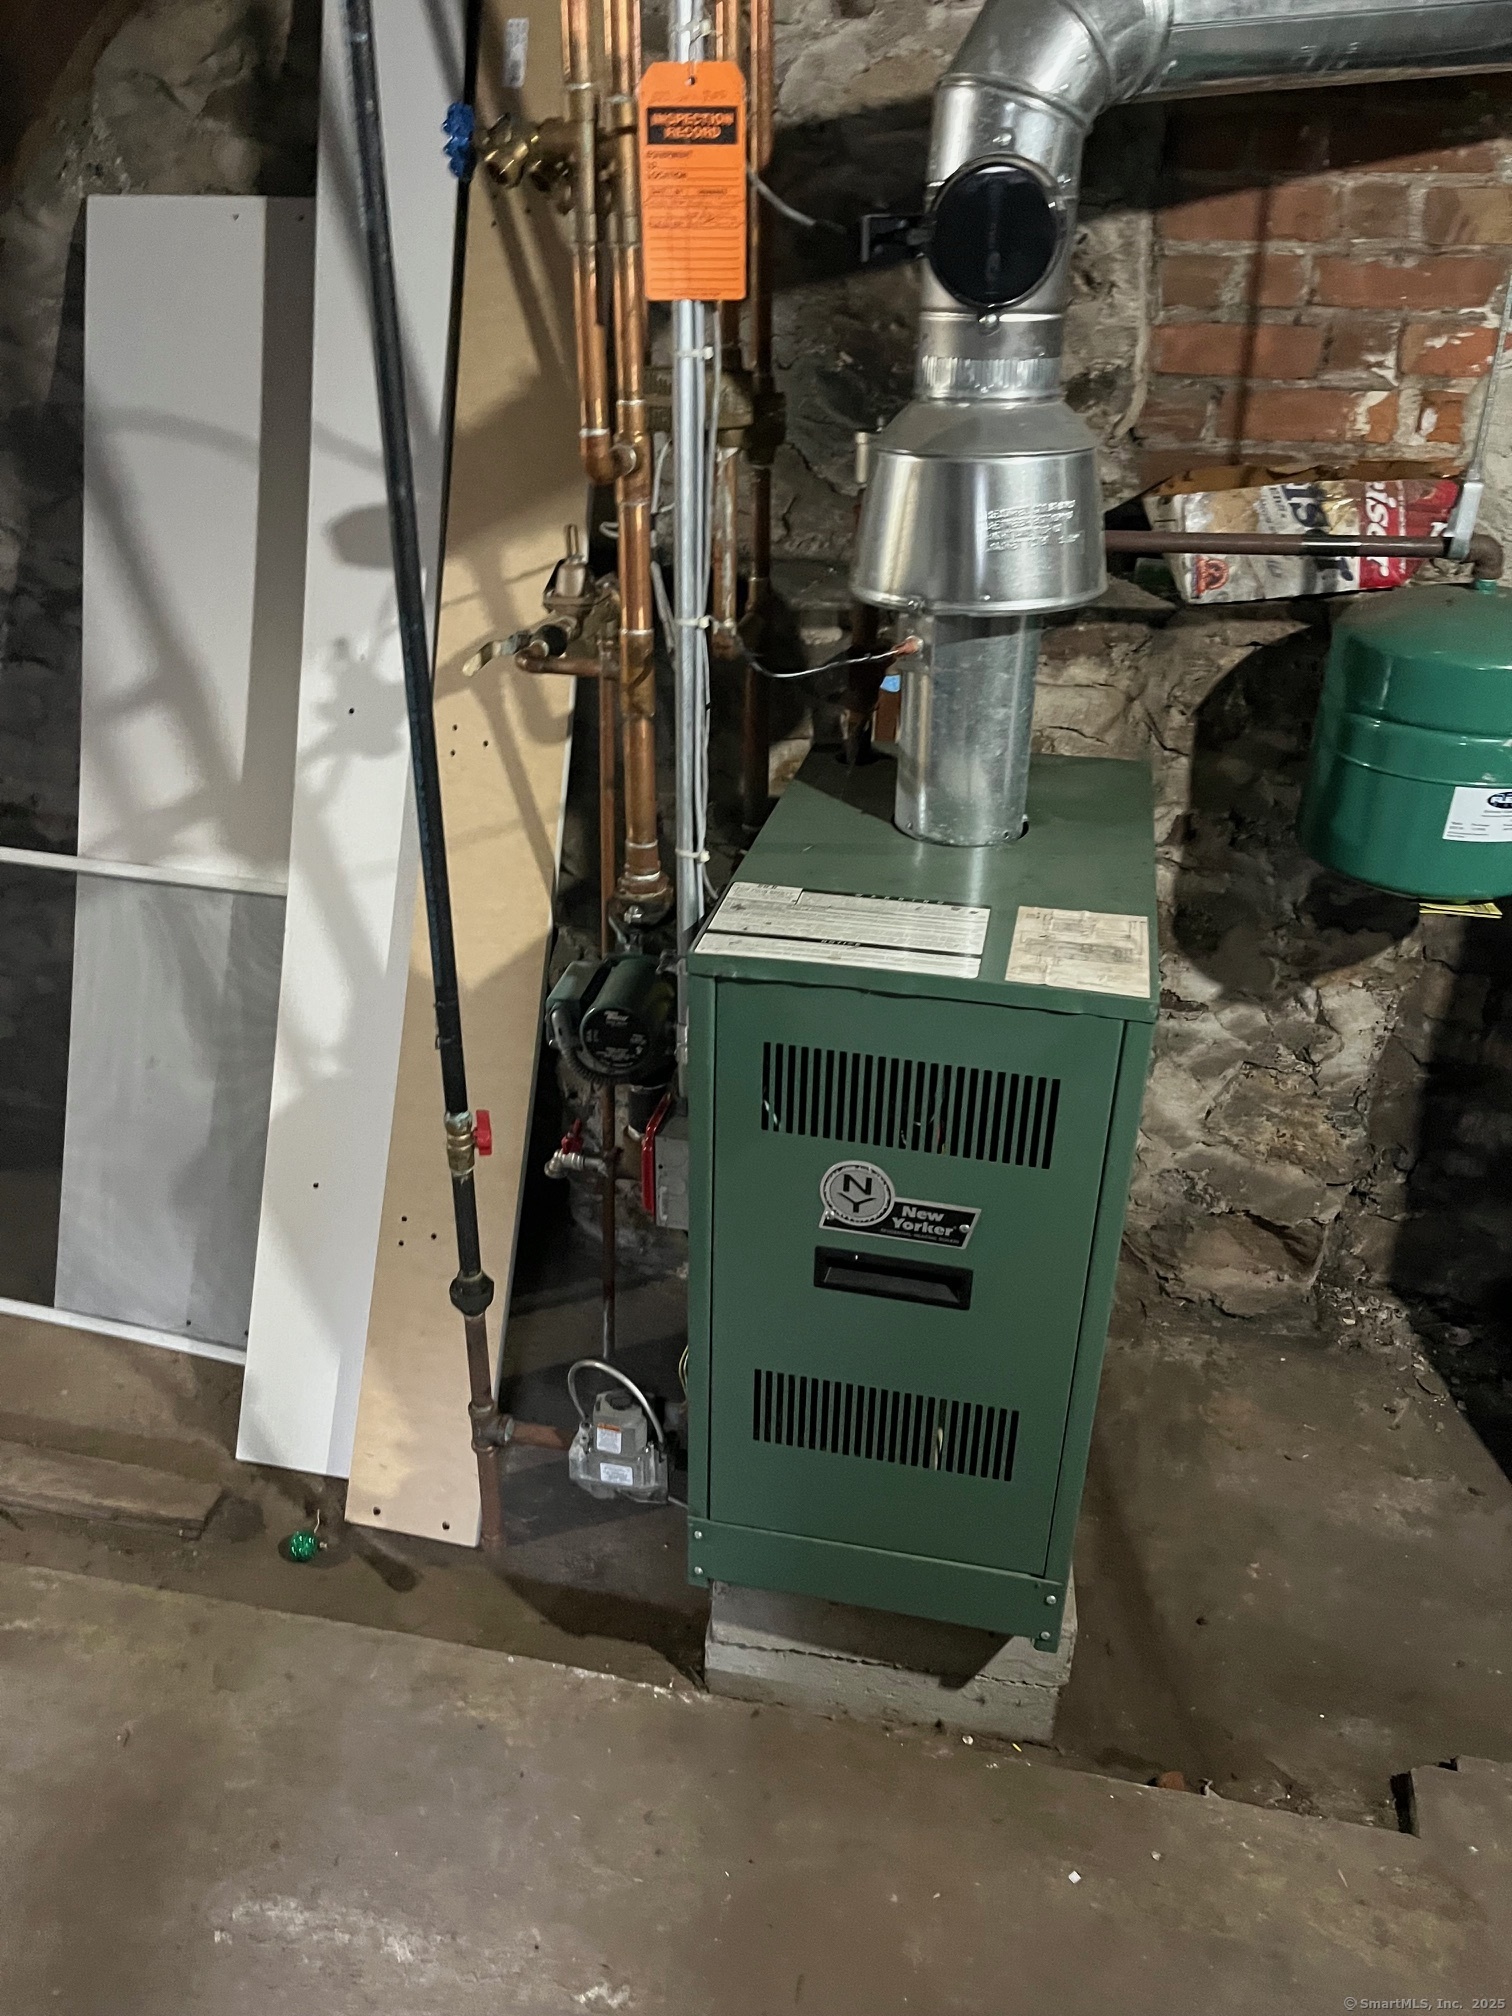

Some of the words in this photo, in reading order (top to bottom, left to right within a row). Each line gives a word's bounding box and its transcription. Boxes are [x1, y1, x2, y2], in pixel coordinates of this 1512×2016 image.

[650, 112, 734, 126] INSPECTION
[663, 126, 721, 139] RECORD
[902, 1205, 945, 1222] New
[892, 1217, 954, 1236] Yorker
